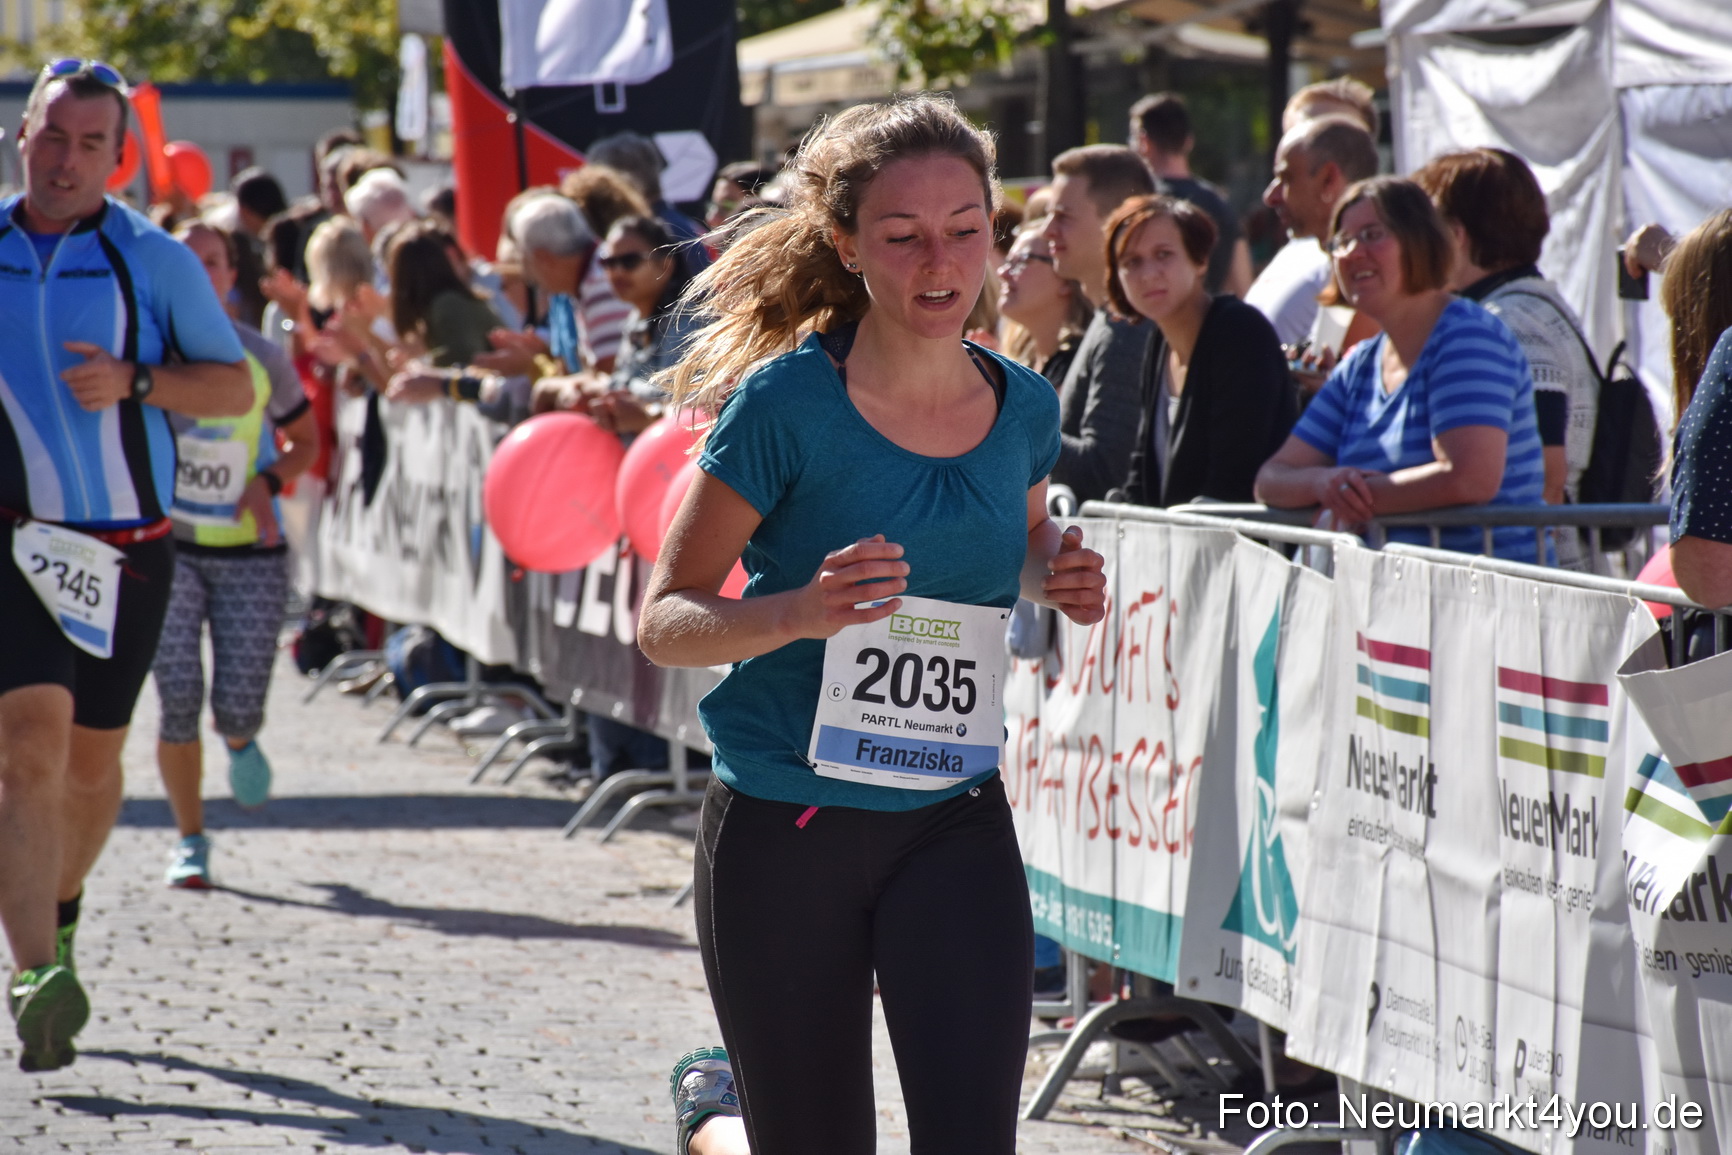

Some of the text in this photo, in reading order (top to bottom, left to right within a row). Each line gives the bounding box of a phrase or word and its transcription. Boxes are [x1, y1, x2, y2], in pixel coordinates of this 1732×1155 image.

[178, 461, 230, 490] 900
[890, 614, 961, 640] BOCK
[888, 634, 915, 643] inspired
[938, 640, 960, 648] concepts
[852, 648, 977, 715] 2035
[861, 713, 953, 734] PARTL Neumarkt
[856, 738, 963, 773] Franziska
